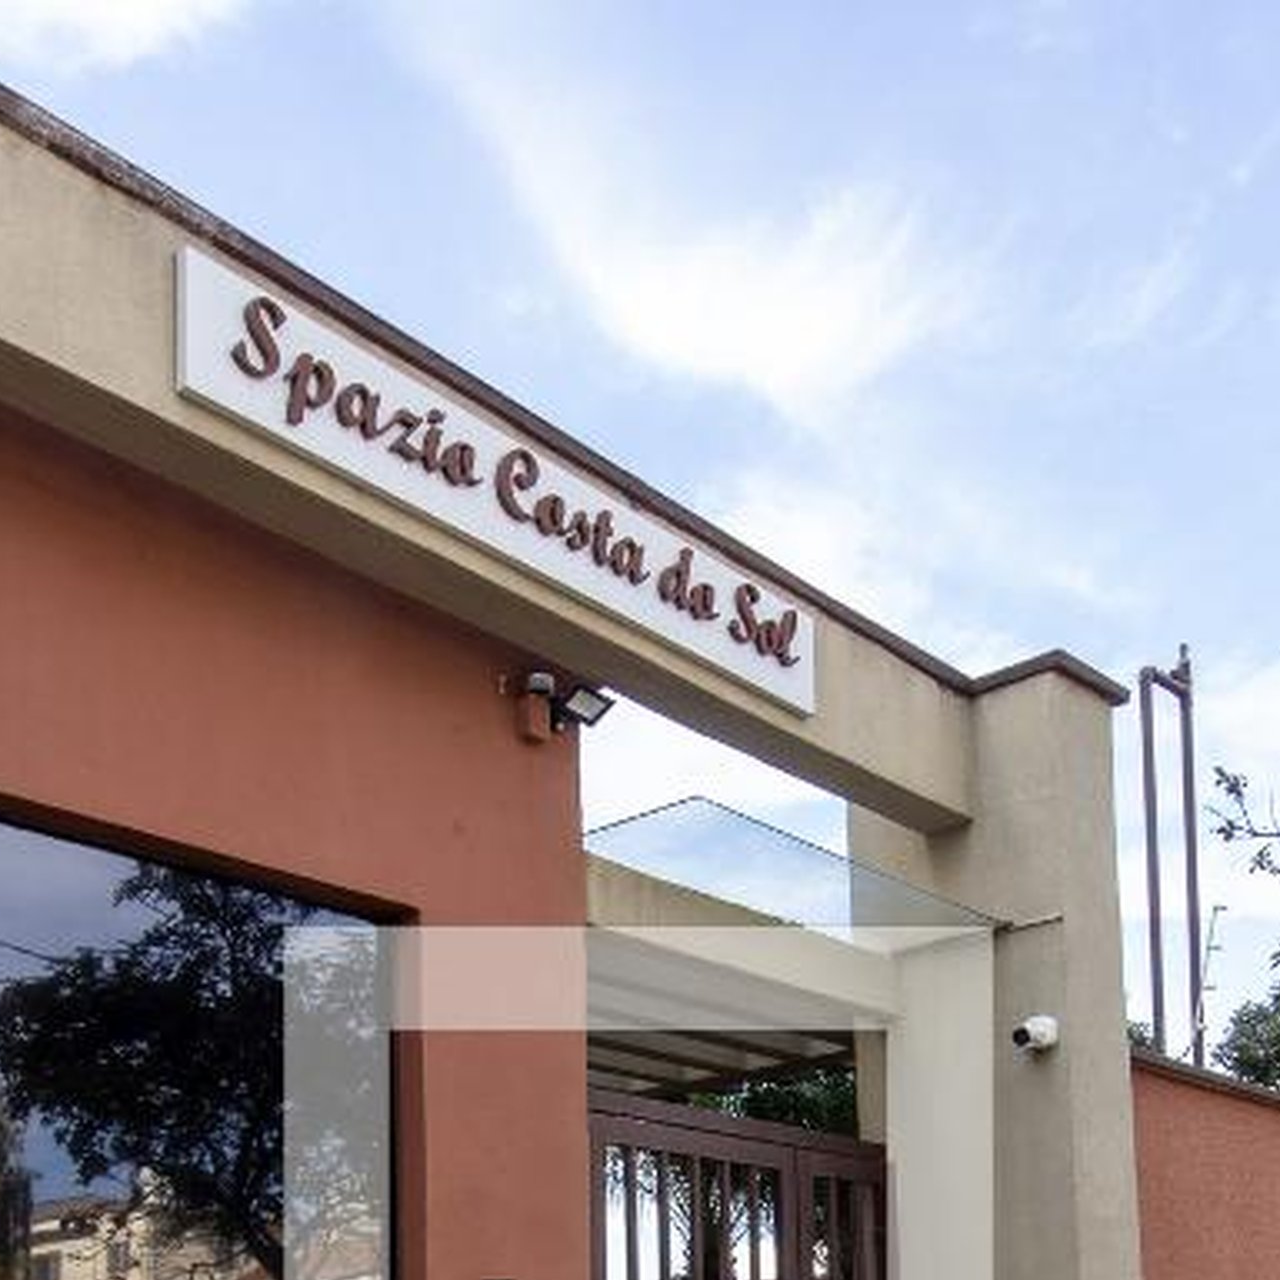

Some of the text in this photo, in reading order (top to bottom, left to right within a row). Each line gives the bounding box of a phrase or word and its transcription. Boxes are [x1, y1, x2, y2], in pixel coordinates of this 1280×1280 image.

[230, 295, 800, 668] Spazio Costa do Sol
